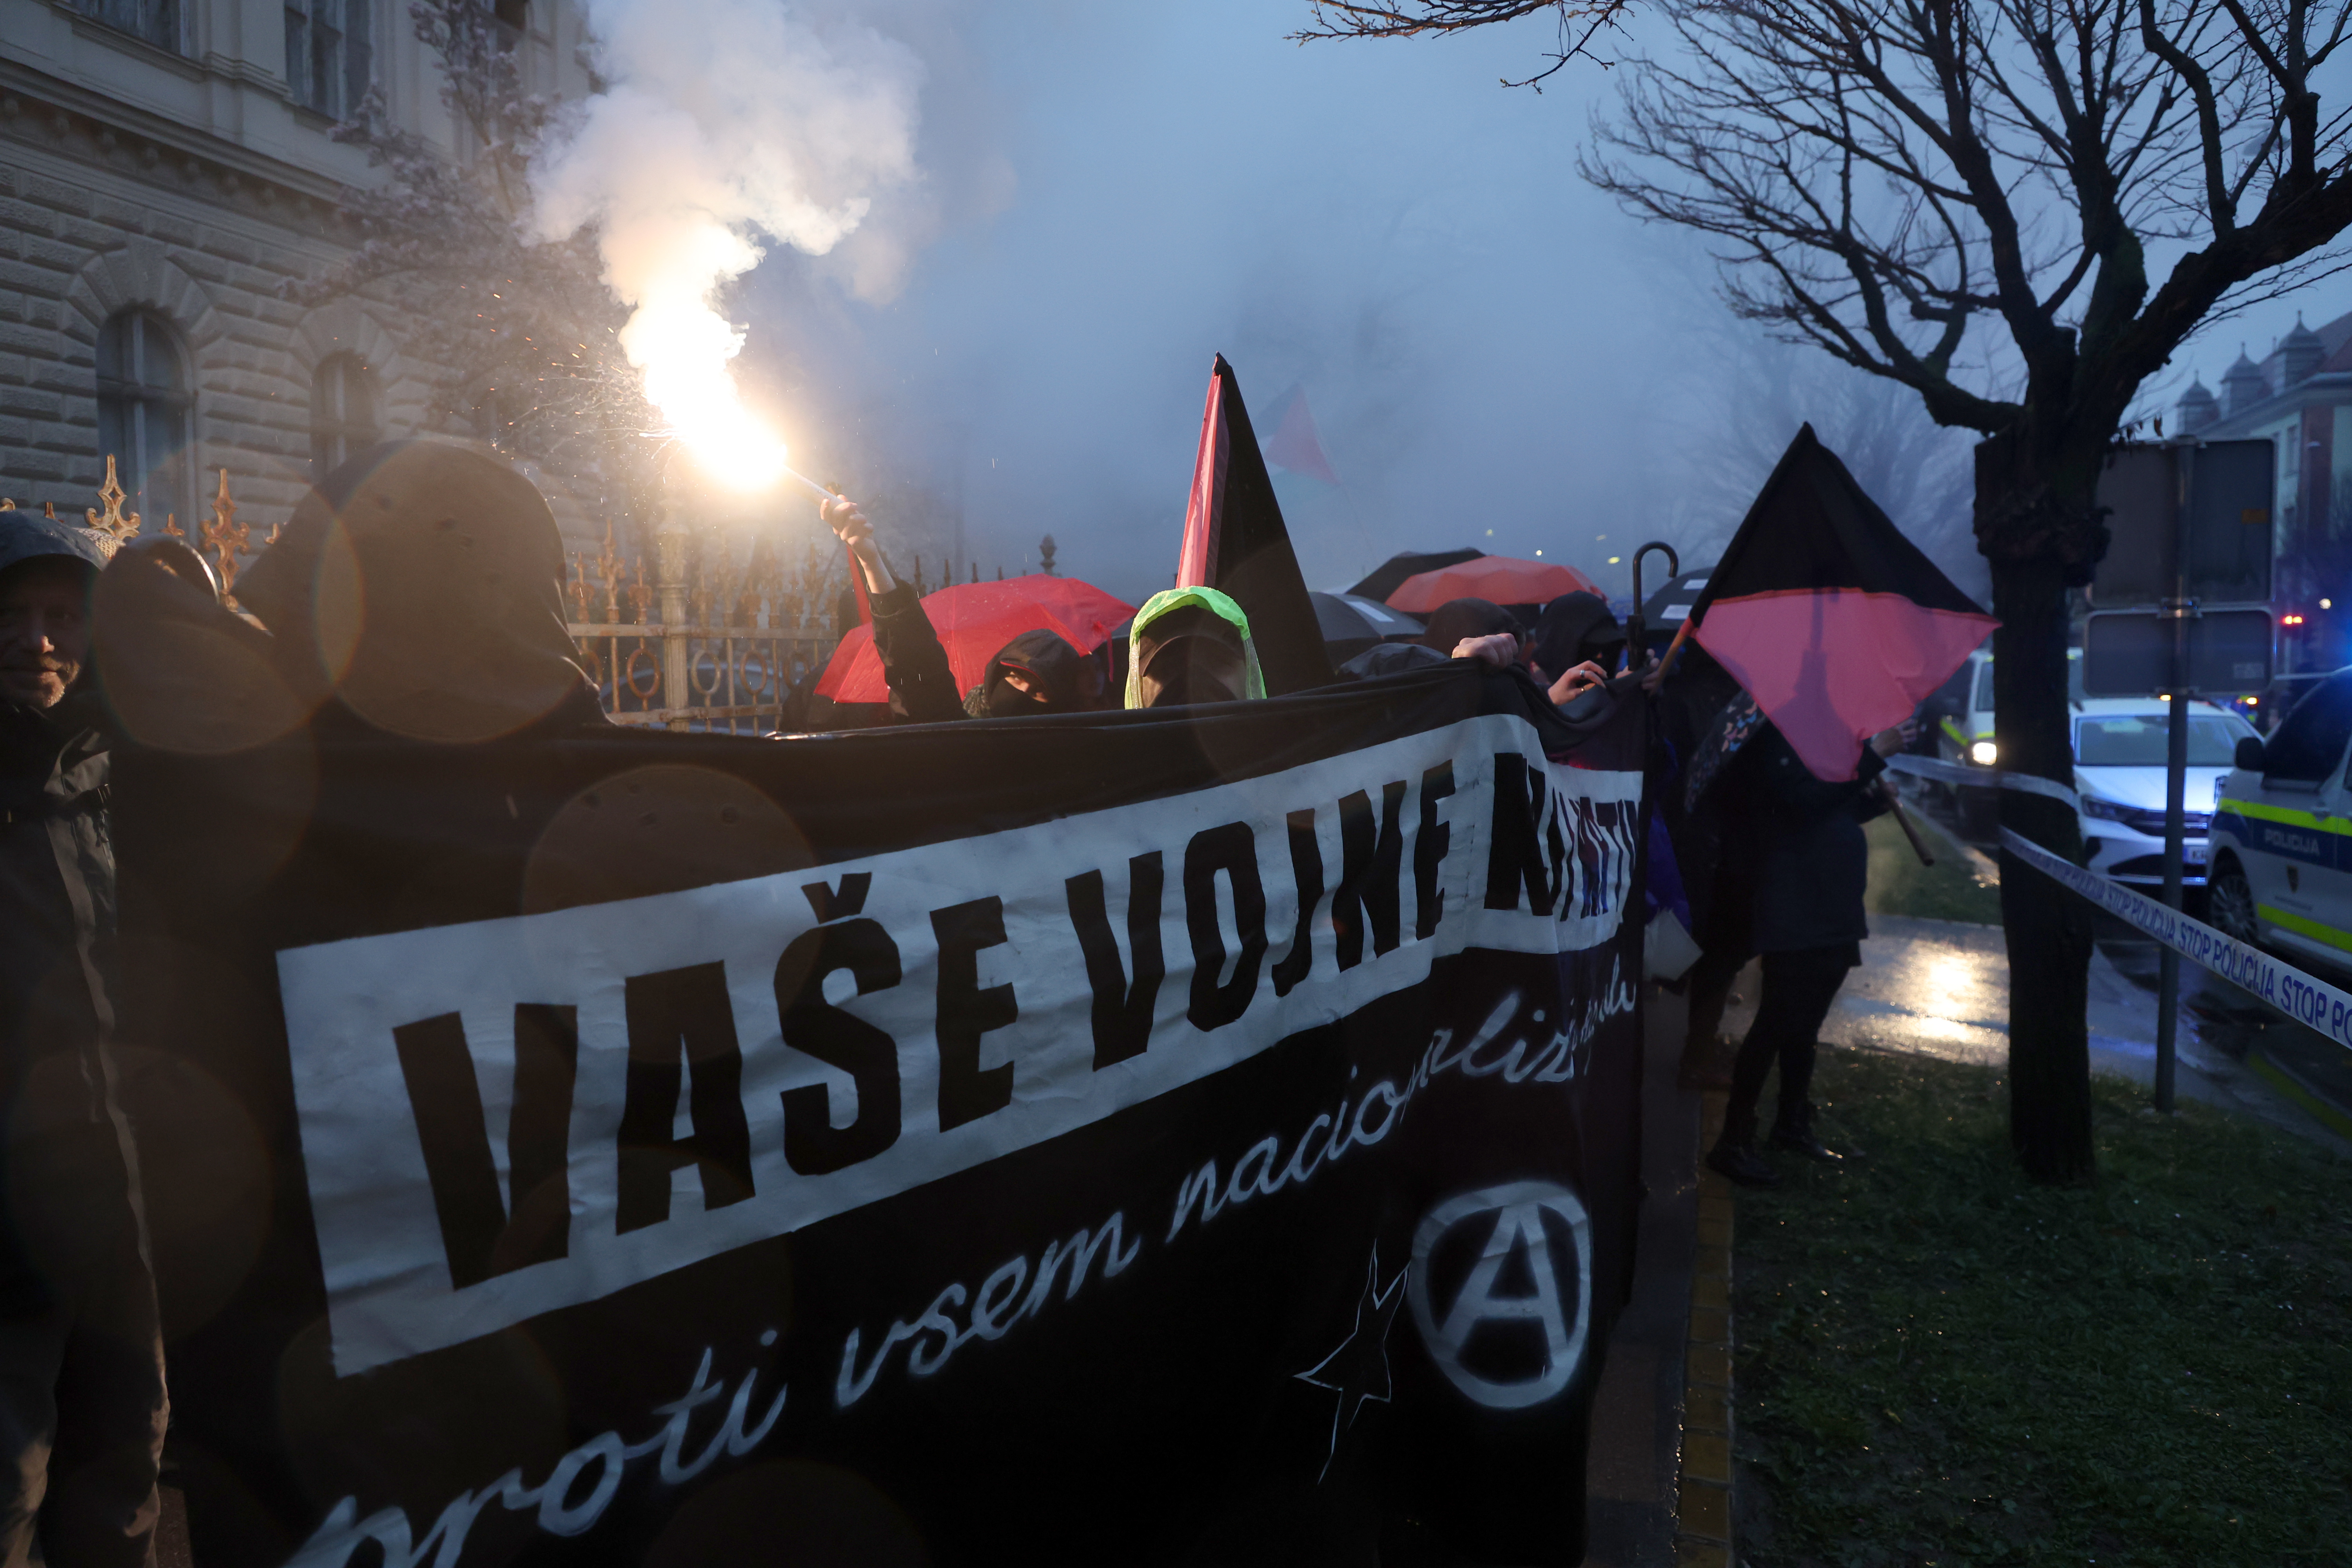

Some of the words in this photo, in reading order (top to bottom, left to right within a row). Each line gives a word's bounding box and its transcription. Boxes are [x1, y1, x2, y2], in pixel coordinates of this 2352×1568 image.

[2265, 828, 2320, 857] POLICIJA
[392, 871, 1018, 1292] VAŠE
[1064, 759, 1456, 1072] VOJNE
[2132, 896, 2176, 945] POLICIJA
[2178, 921, 2211, 964] STOP
[2213, 939, 2276, 1004] POLICIJA
[2281, 975, 2328, 1029] STOP
[836, 1210, 1142, 1408] vsem
